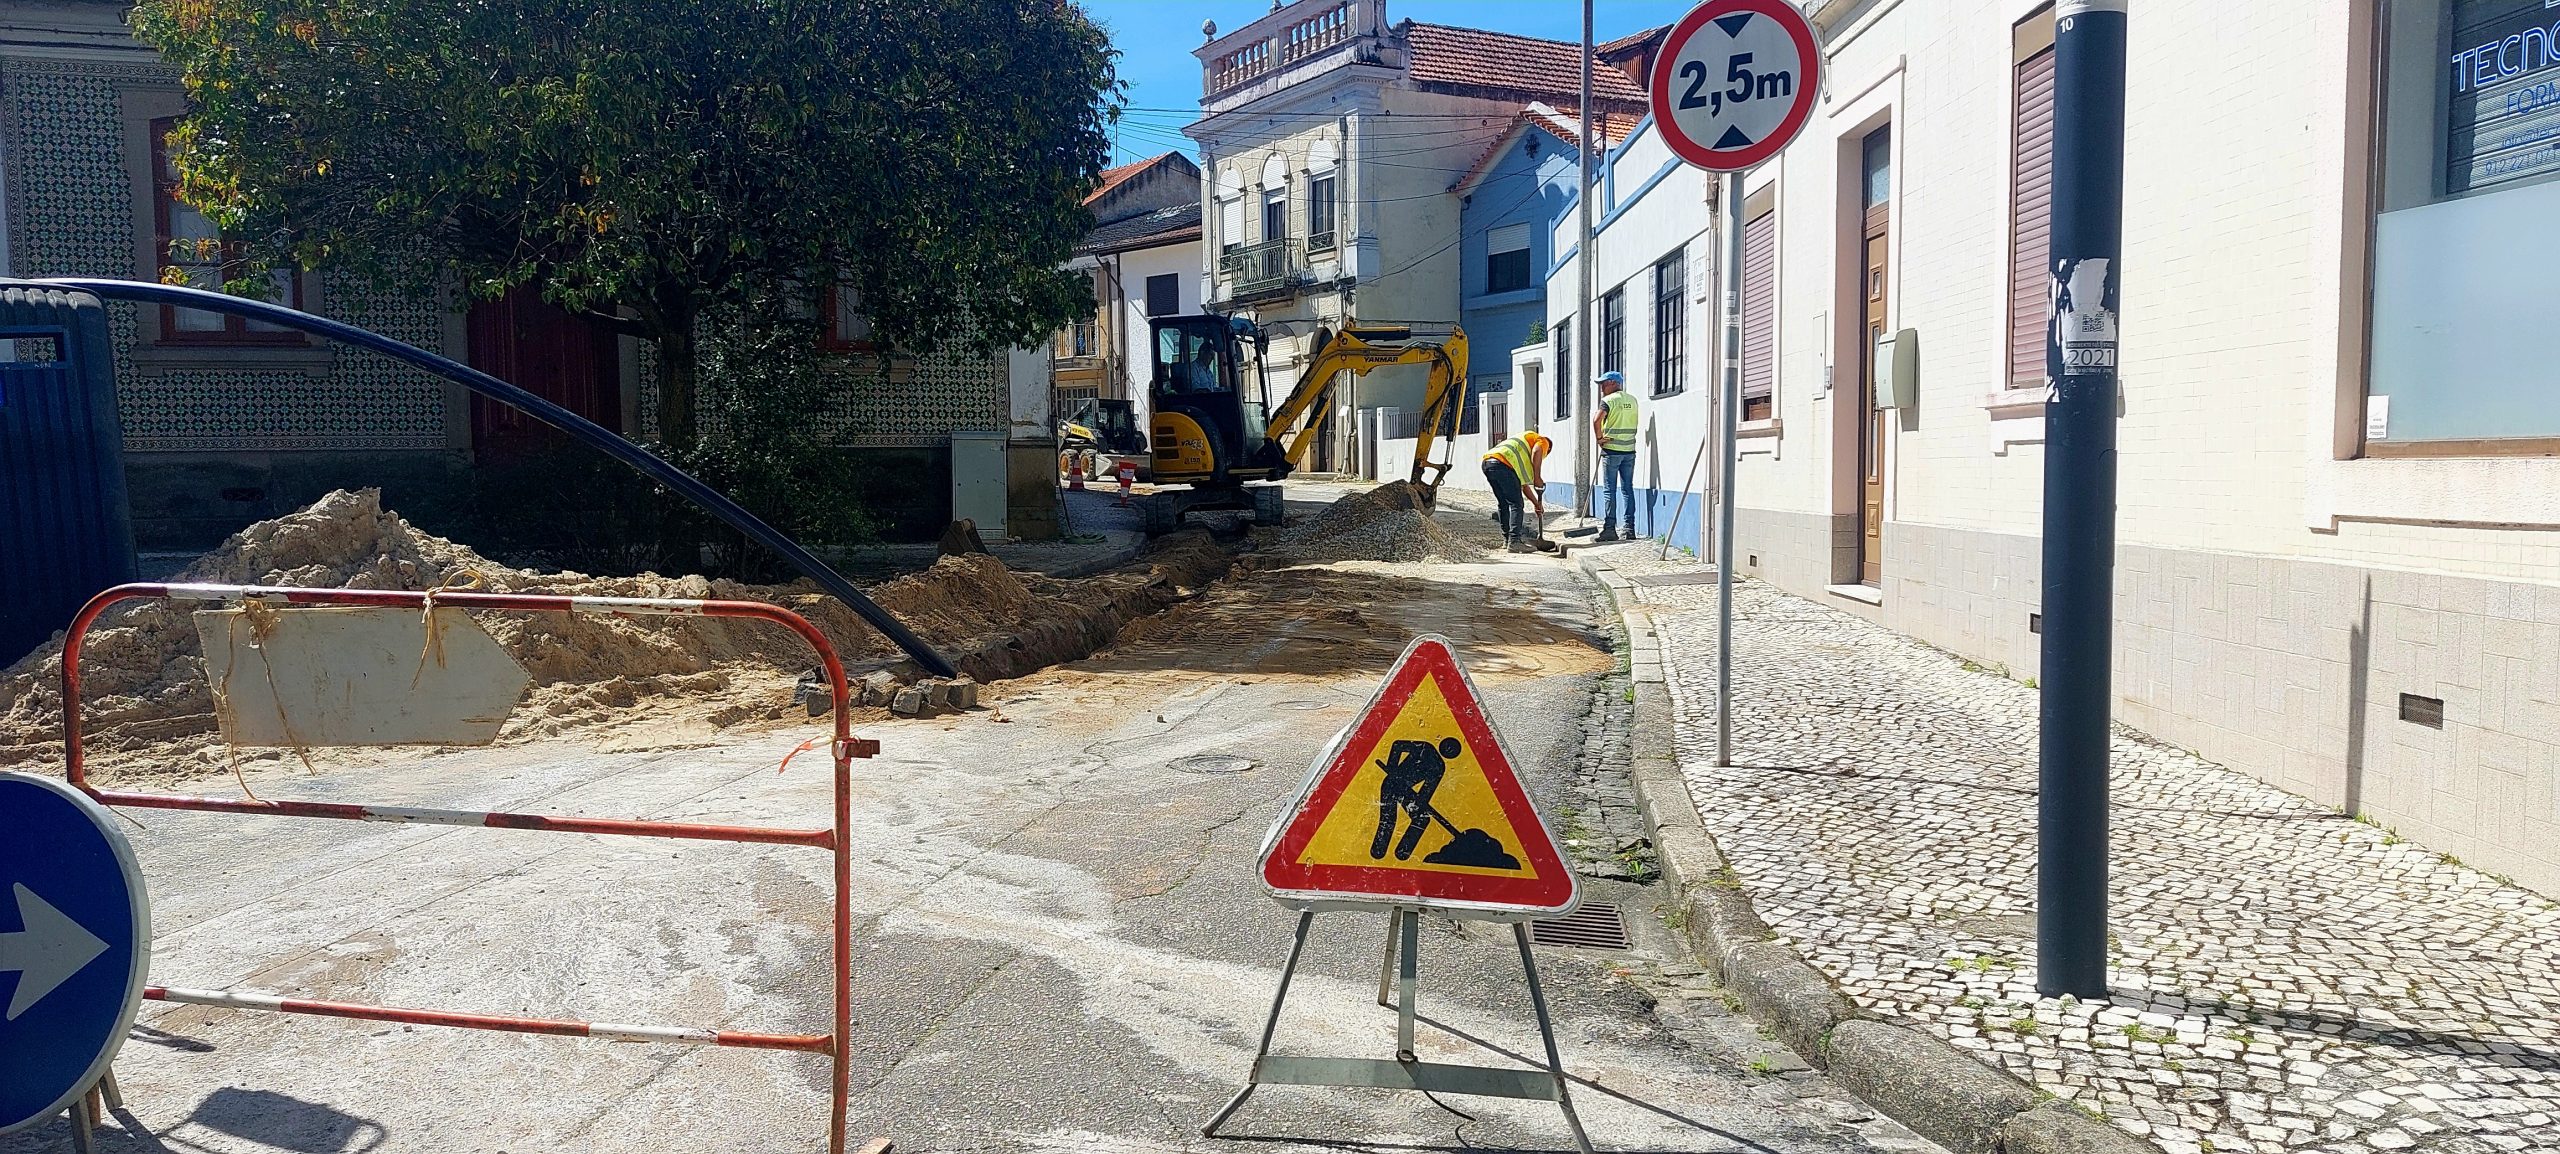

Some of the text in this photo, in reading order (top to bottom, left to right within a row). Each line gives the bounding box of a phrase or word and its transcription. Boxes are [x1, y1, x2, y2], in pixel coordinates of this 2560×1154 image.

[2060, 17, 2074, 33] 10
[1678, 52, 1791, 119] 2,5m
[2069, 349, 2112, 366] 2021
